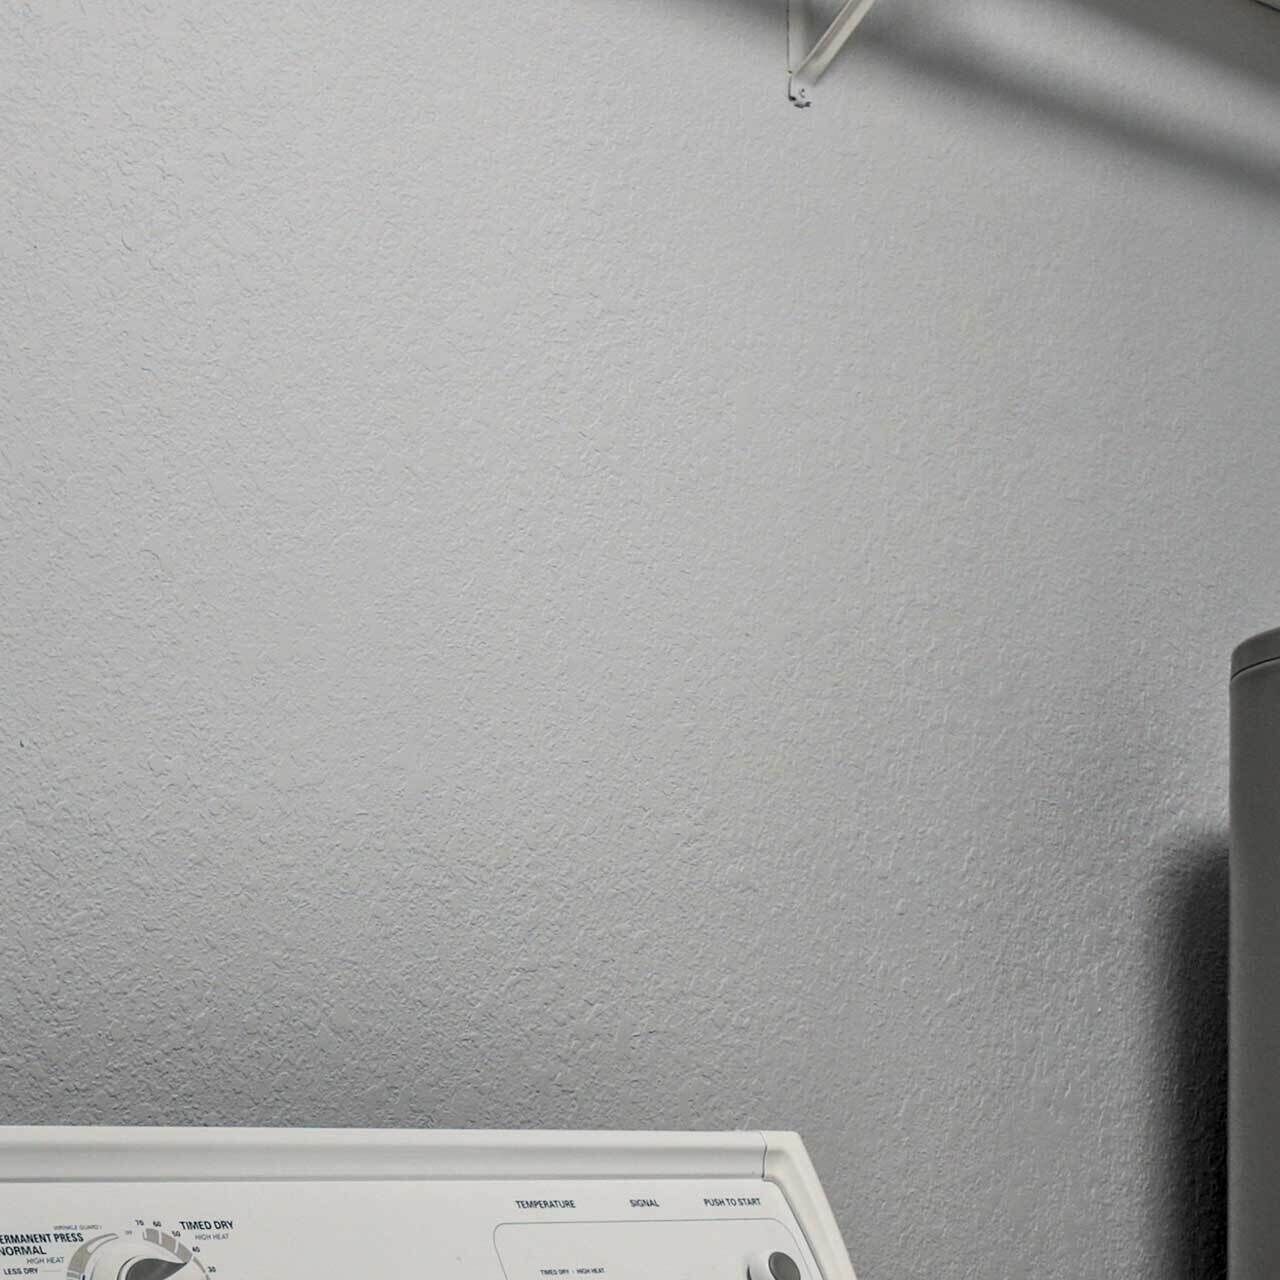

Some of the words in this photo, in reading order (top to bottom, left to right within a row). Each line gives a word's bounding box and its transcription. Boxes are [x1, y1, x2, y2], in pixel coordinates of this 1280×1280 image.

[515, 1199, 577, 1209] TEMPERATURE
[629, 1199, 660, 1208] SIGNAL
[703, 1198, 726, 1207] PUSH
[726, 1198, 737, 1207] TO
[737, 1197, 761, 1206] START
[179, 1221, 212, 1231] TIMED
[213, 1220, 234, 1230] DRY
[54, 1232, 85, 1243] PRESS
[171, 1230, 181, 1238] 50
[192, 1246, 201, 1254] 40
[26, 1257, 45, 1265] HIGH
[46, 1256, 65, 1264] HEAT
[3, 1268, 23, 1276] LESS
[23, 1267, 39, 1275] DRY
